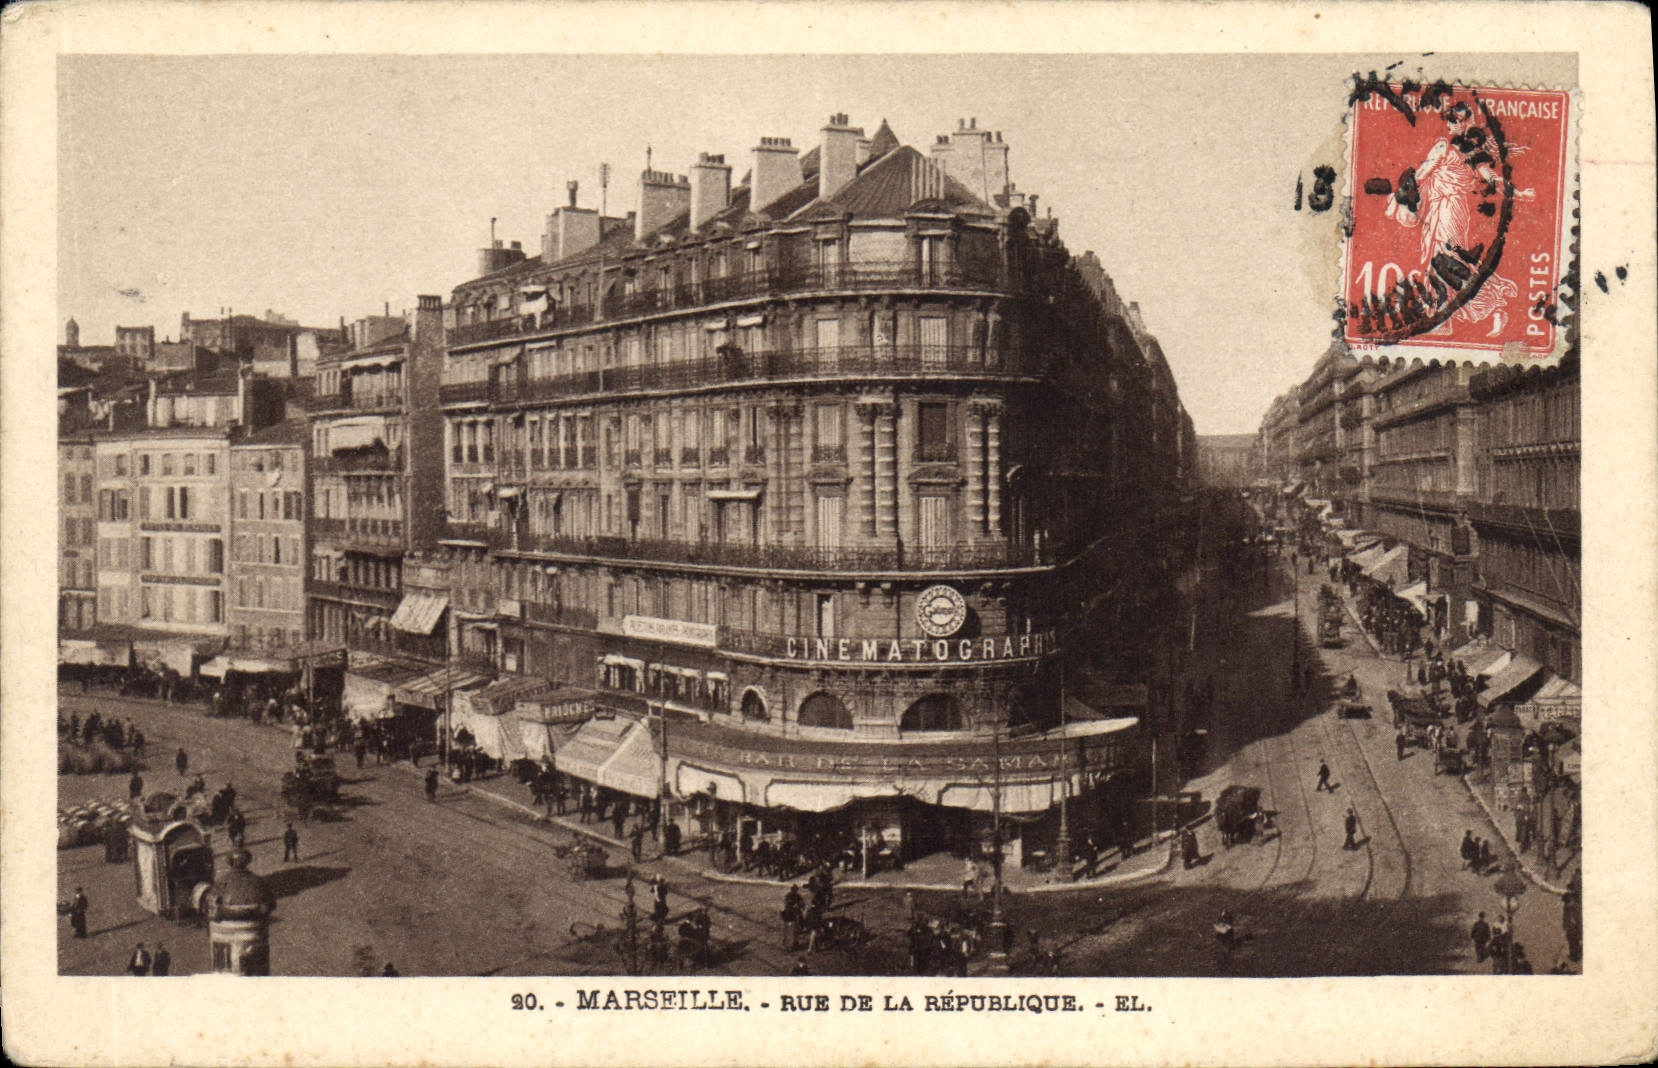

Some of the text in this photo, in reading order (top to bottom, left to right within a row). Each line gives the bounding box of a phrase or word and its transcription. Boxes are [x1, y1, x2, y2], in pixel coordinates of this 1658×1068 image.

[1477, 99, 1559, 120] FRANÇAISE
[1526, 252, 1551, 337] POSTES
[739, 750, 796, 769] BAR
